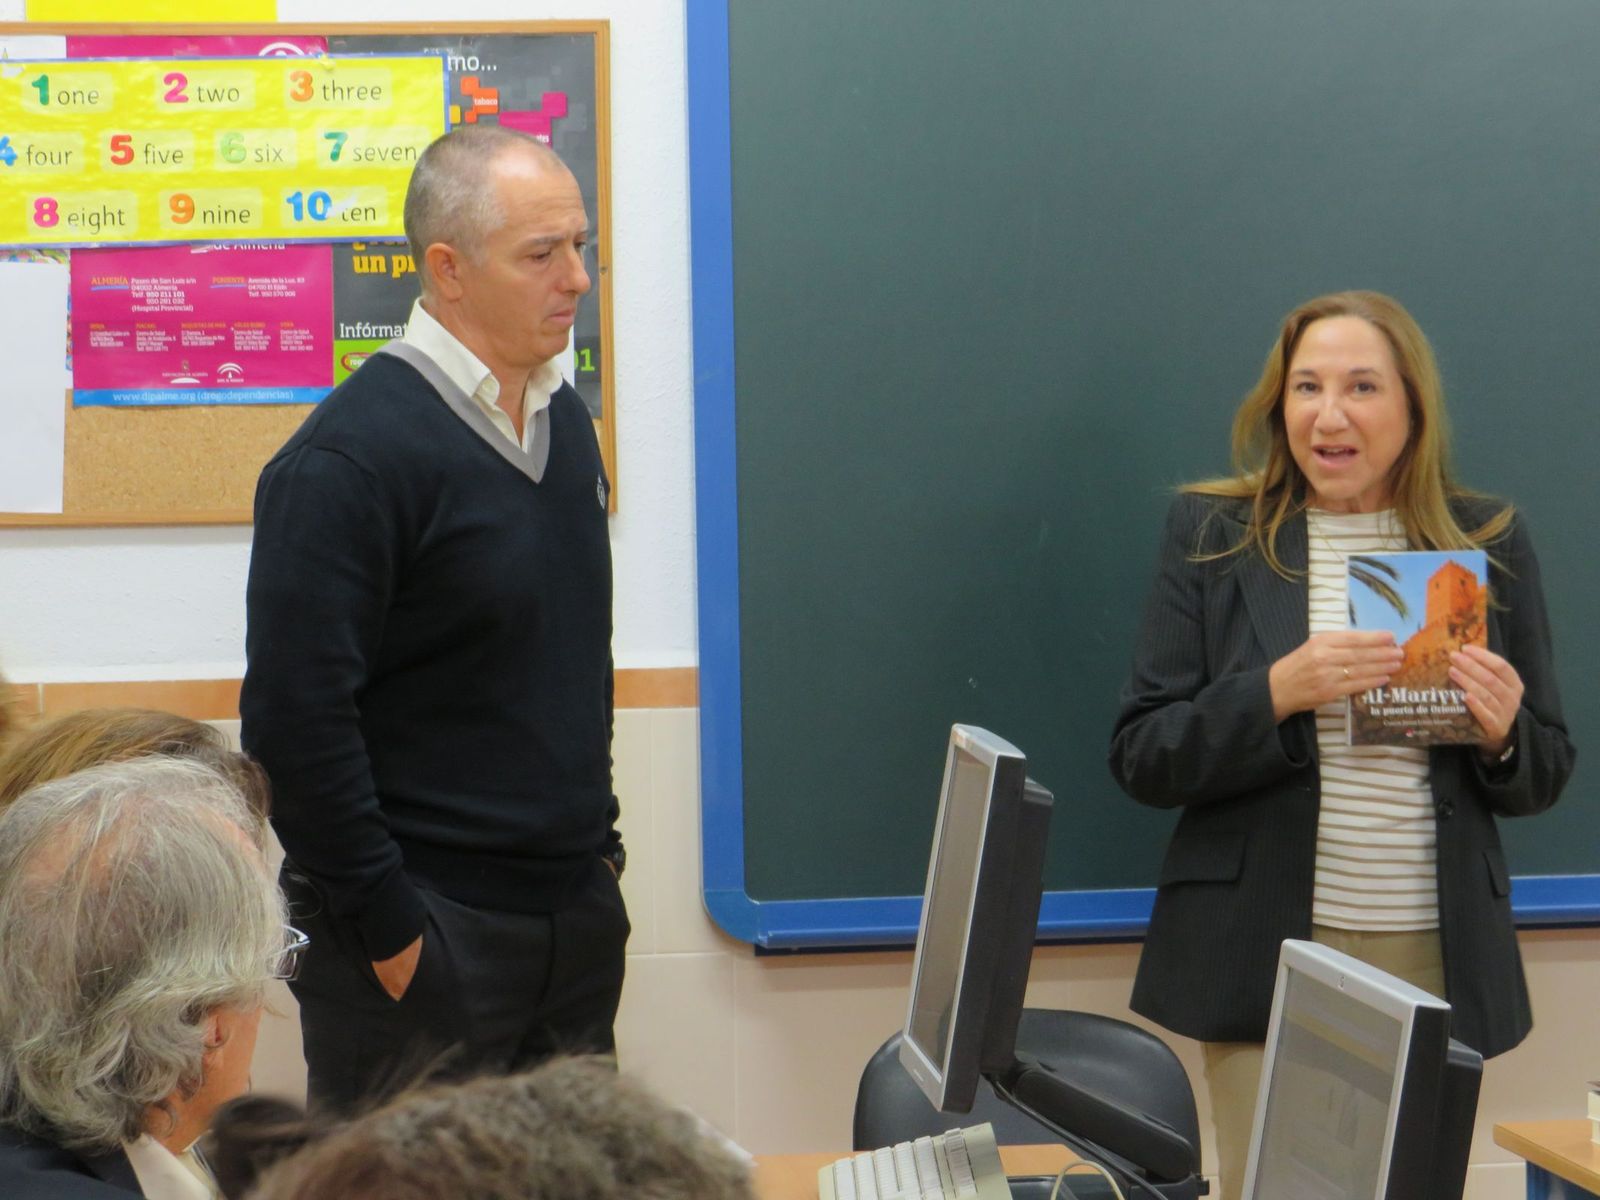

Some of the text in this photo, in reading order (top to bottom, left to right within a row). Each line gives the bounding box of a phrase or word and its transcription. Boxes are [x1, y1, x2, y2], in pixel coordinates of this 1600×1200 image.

[32, 74, 100, 106] 1 one
[163, 72, 240, 104] 2 two
[290, 70, 382, 102] 3 three
[26, 144, 73, 166] four
[110, 134, 184, 165] 5 five
[220, 132, 284, 164] 6 six
[324, 131, 417, 162] 7 seven
[33, 197, 125, 235] 8 eight
[169, 193, 251, 225] 9 nine
[286, 191, 333, 222] 10
[352, 255, 387, 273] un
[91, 276, 128, 285] ALMERÍA
[113, 389, 294, 402] www.dipalme.org (drogodependencias)
[1370, 706, 1380, 716] la
[1383, 705, 1414, 716] puerta
[1416, 705, 1428, 714] de
